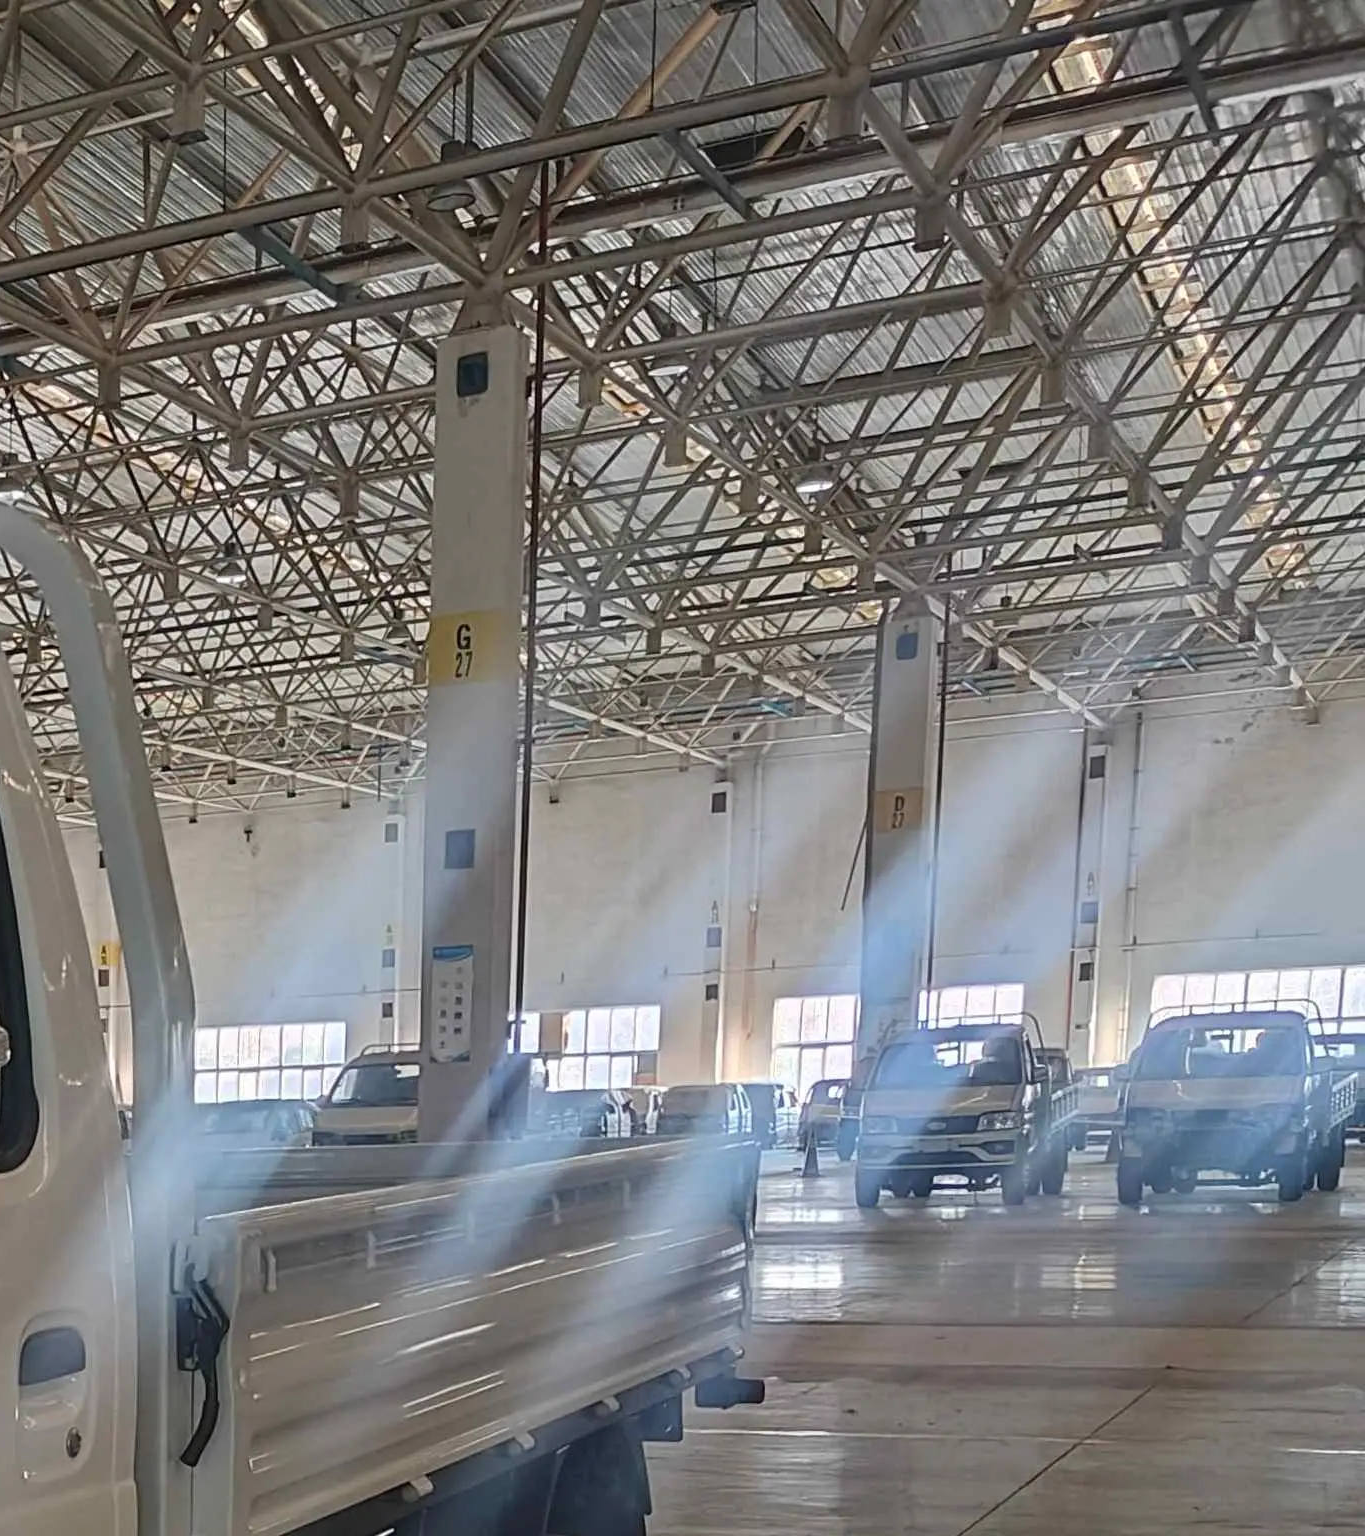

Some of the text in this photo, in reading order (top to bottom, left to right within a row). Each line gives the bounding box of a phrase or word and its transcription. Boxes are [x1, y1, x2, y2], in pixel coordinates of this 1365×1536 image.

[457, 624, 471, 650] G
[456, 651, 473, 678] 27
[895, 795, 905, 811] D
[892, 812, 905, 829] 27
